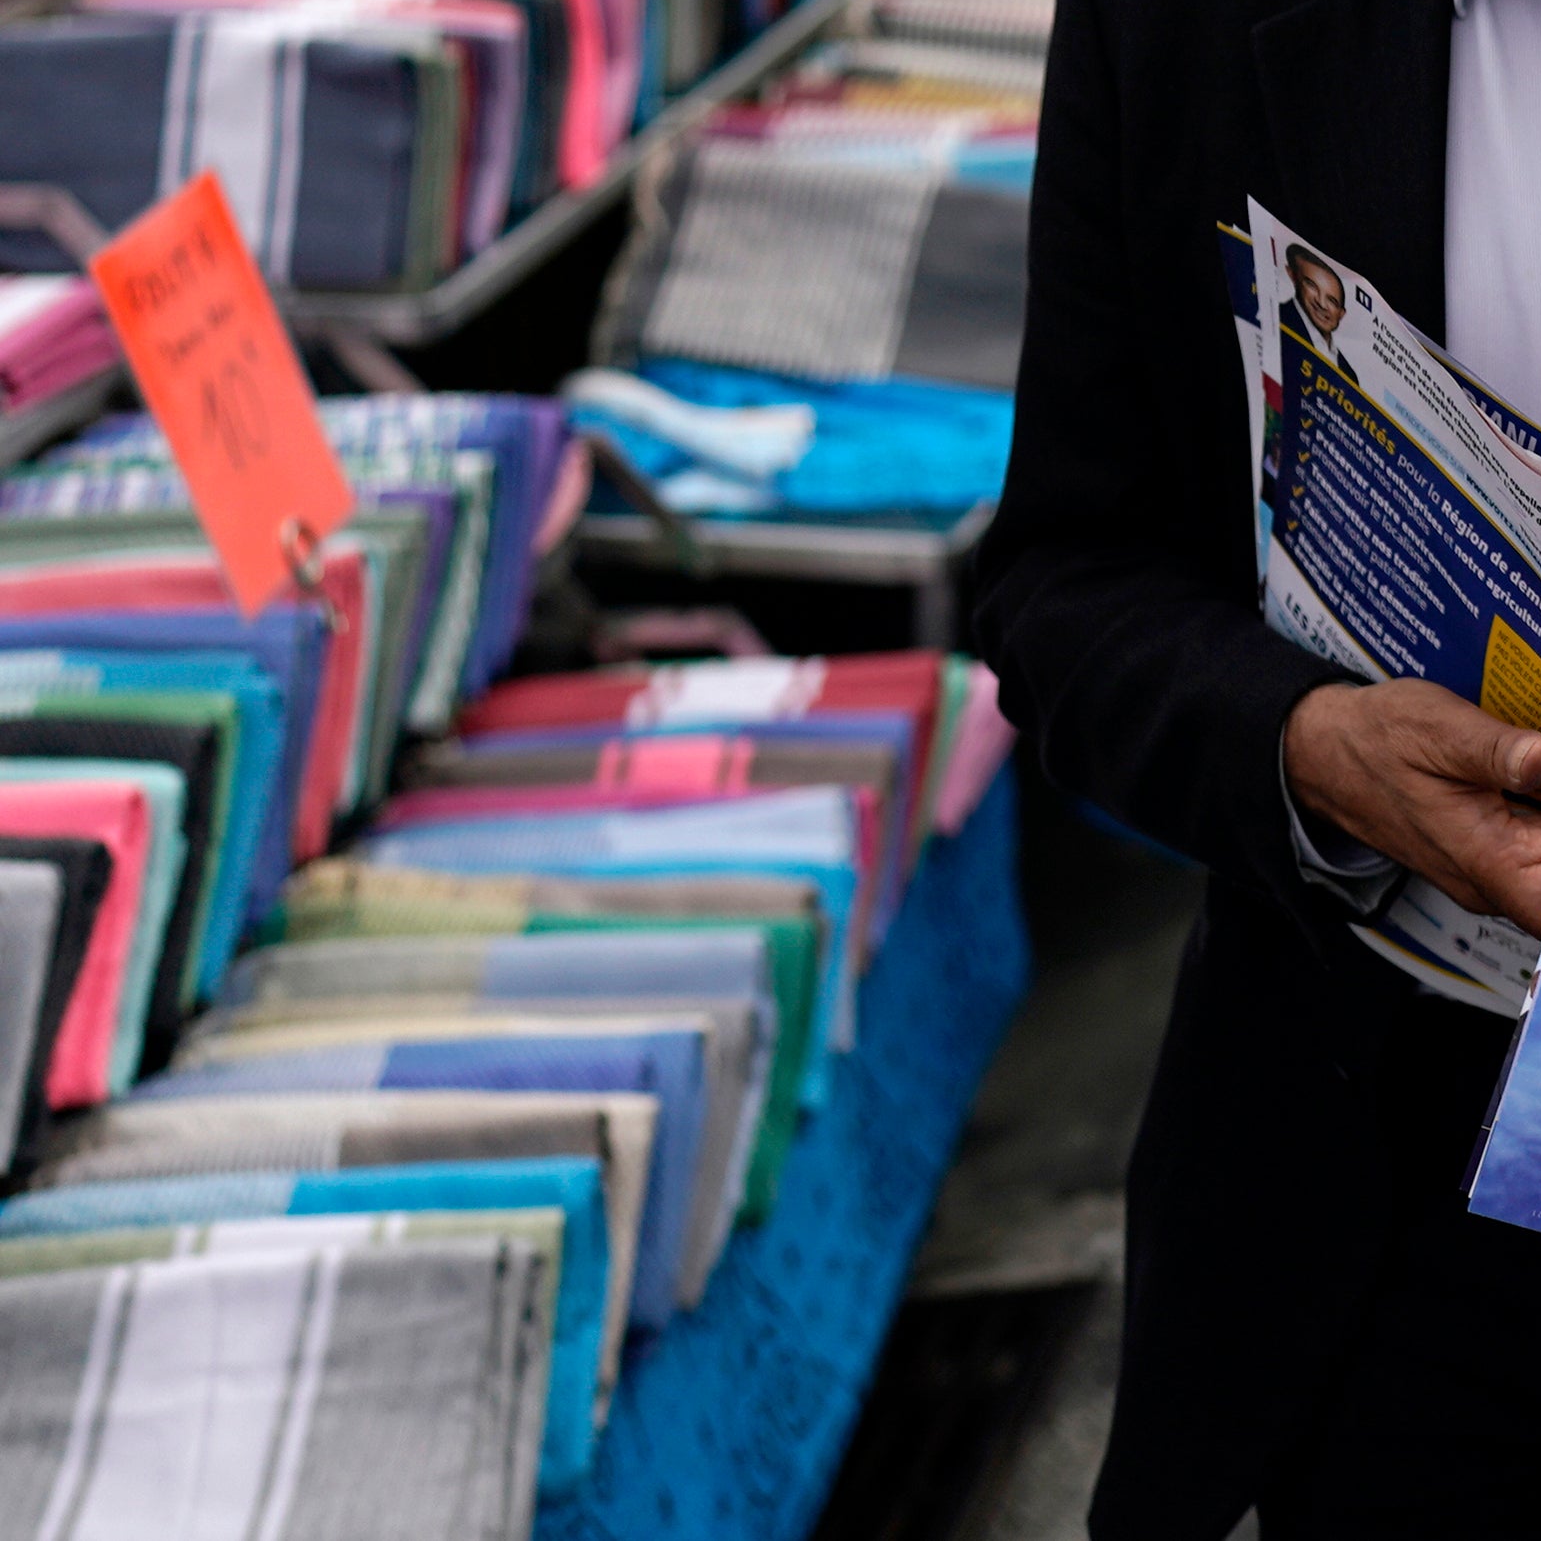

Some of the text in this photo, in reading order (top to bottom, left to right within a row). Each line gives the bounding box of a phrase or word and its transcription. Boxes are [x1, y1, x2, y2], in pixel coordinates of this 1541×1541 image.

[1299, 354, 1313, 382] 5
[1315, 371, 1396, 459] priorités
[1396, 450, 1427, 492] pour
[1427, 479, 1441, 507] la
[1440, 495, 1489, 558] Région
[1489, 543, 1508, 577] de
[1300, 395, 1431, 538] pour défendre nos emplois
[1372, 339, 1402, 378] Région
[1403, 371, 1417, 392] est
[1417, 387, 1439, 416] entre
[1440, 412, 1454, 433] vos
[1455, 429, 1479, 462] mains
[1372, 327, 1395, 357] choix
[1396, 351, 1415, 378] d'un
[1416, 374, 1452, 419] véritable
[1454, 414, 1501, 481] changement.
[1380, 320, 1420, 371] l'occasion
[1421, 366, 1431, 382] de
[1432, 380, 1445, 399] ces
[1446, 394, 1481, 445] élections,
[1490, 453, 1508, 479] vous
[1509, 475, 1541, 514] appelle
[1294, 462, 1428, 614] et valoriser notre patrimoine
[1298, 427, 1430, 576] et promouvoir le localisme
[1310, 461, 1446, 616] Transmettre nos traditions
[1314, 426, 1479, 621] Préserver notre environnement
[1315, 393, 1364, 449] Soutenir
[1364, 442, 1385, 471] nos
[1385, 463, 1443, 539] entreprises
[1443, 528, 1454, 549] et
[1453, 539, 1485, 583] notre
[1285, 589, 1309, 635] LES
[1309, 625, 1328, 658] 20
[1288, 497, 1418, 648] en consultant les habitants
[1297, 529, 1425, 679] Rétablir la sécurité partout
[1303, 494, 1442, 652] Faire respirer la démocratie
[1340, 599, 1404, 678] l'islamisme
[1498, 630, 1509, 644] NE
[1509, 643, 1530, 665] VOUS
[1492, 655, 1528, 696] ÉLECTION
[1495, 644, 1509, 660] PAS
[1510, 658, 1534, 685] VOLER
